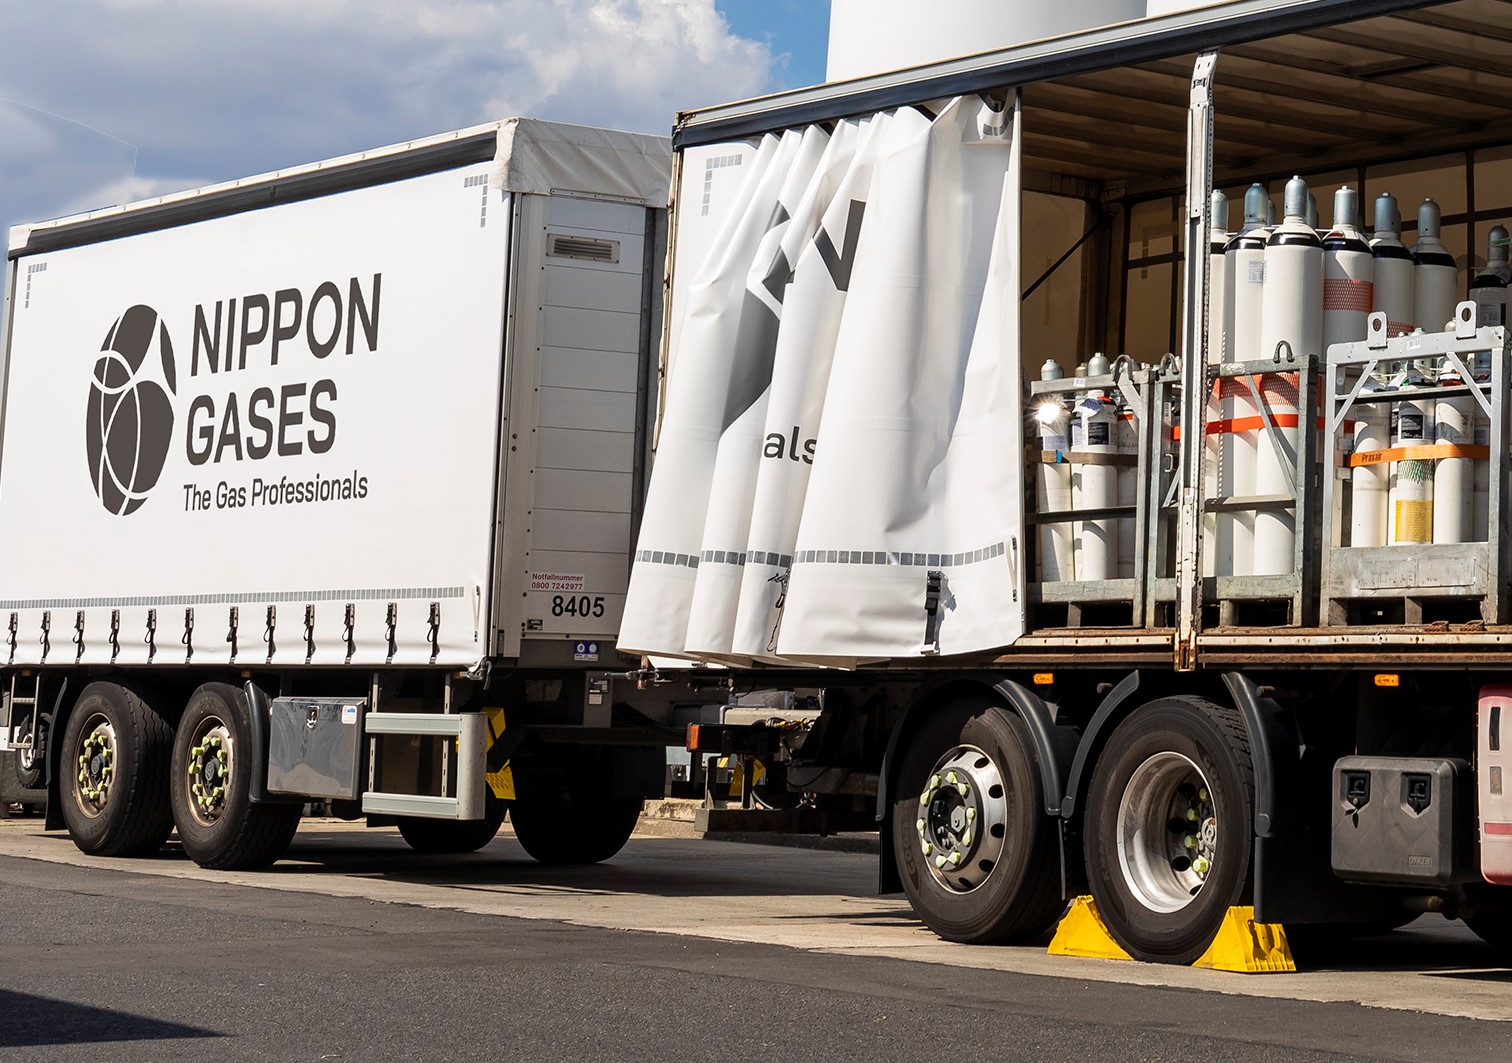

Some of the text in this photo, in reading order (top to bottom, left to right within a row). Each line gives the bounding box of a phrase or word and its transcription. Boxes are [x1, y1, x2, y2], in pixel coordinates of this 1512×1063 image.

[190, 272, 382, 377] NIPPON
[186, 379, 338, 466] GASES
[1362, 452, 1382, 463] Praxair
[183, 469, 368, 511] The Gas Professionals
[532, 573, 583, 582] Notfallnummer
[552, 582, 583, 590] 7242977
[551, 595, 605, 617] 8405
